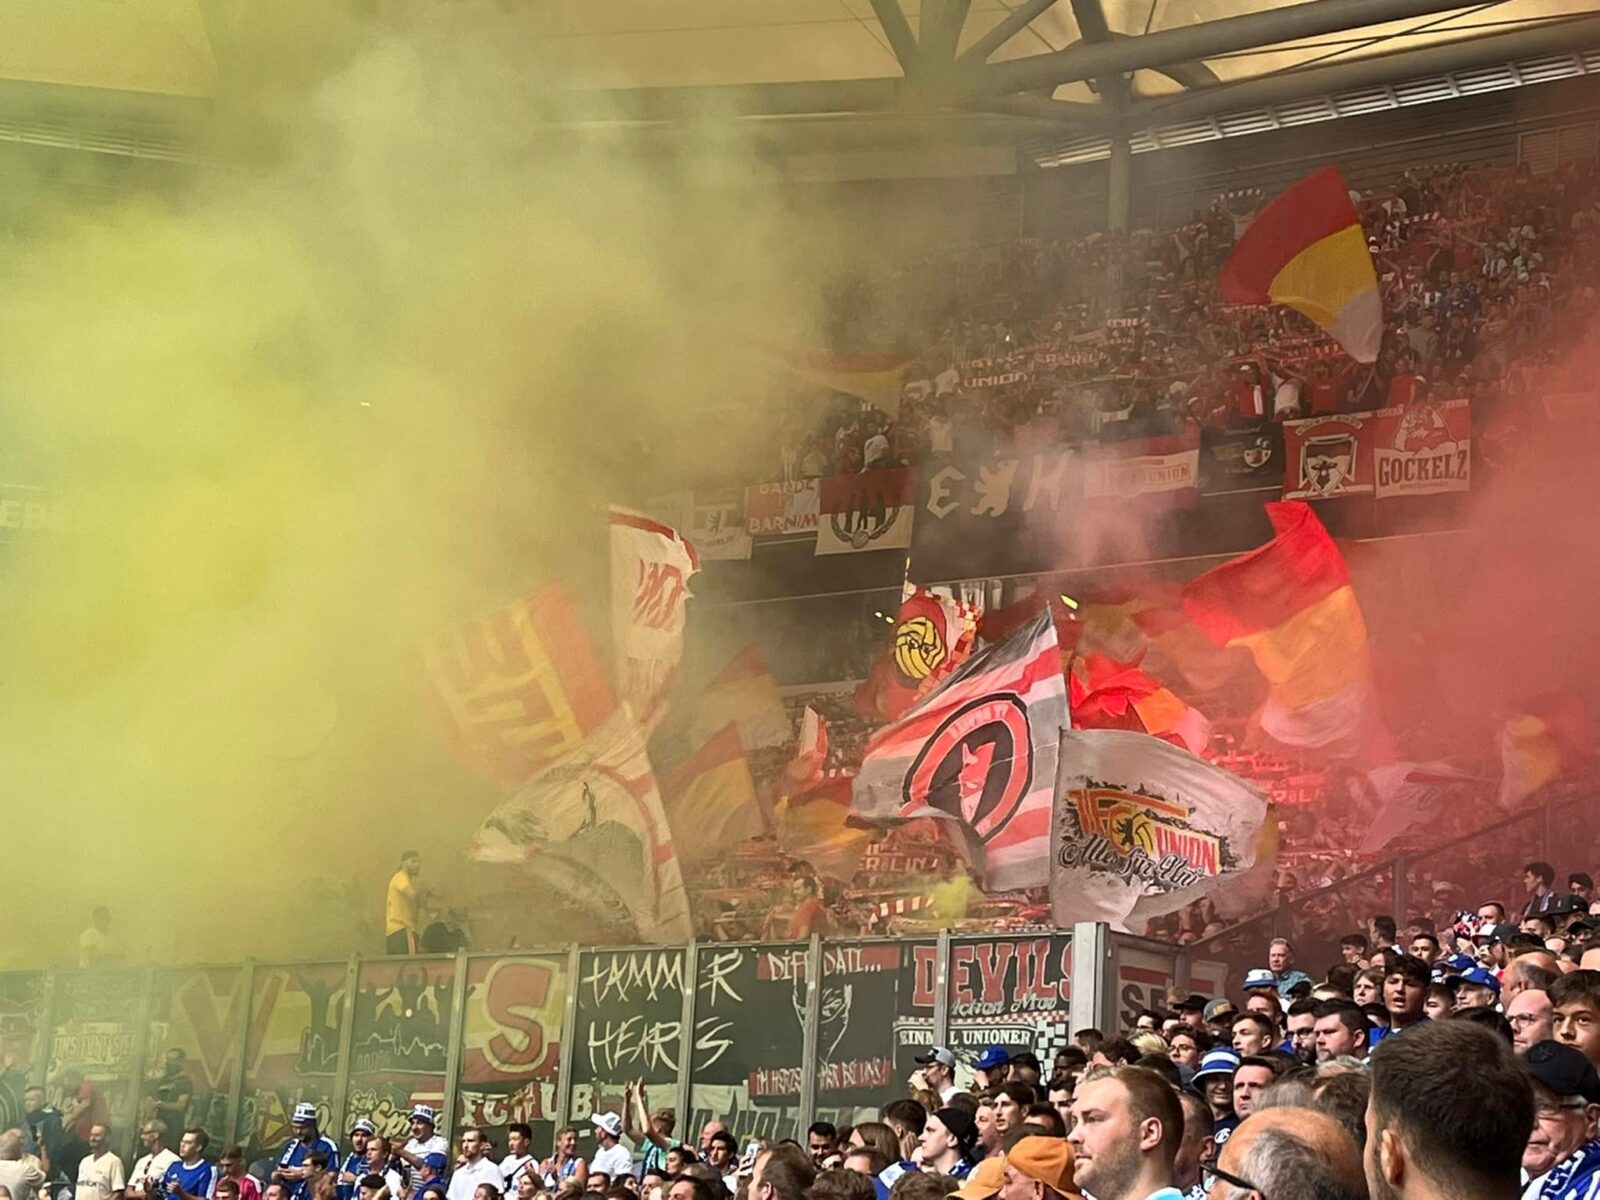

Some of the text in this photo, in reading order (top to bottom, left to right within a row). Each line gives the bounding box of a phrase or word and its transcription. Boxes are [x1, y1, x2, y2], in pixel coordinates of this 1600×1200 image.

[1147, 465, 1190, 483] UNION
[1378, 449, 1468, 486] GOCKELZ
[749, 512, 819, 534] BARNIM
[1154, 826, 1216, 876] UNION
[961, 1029, 1031, 1046] UNIONER
[459, 1088, 510, 1127] FC
